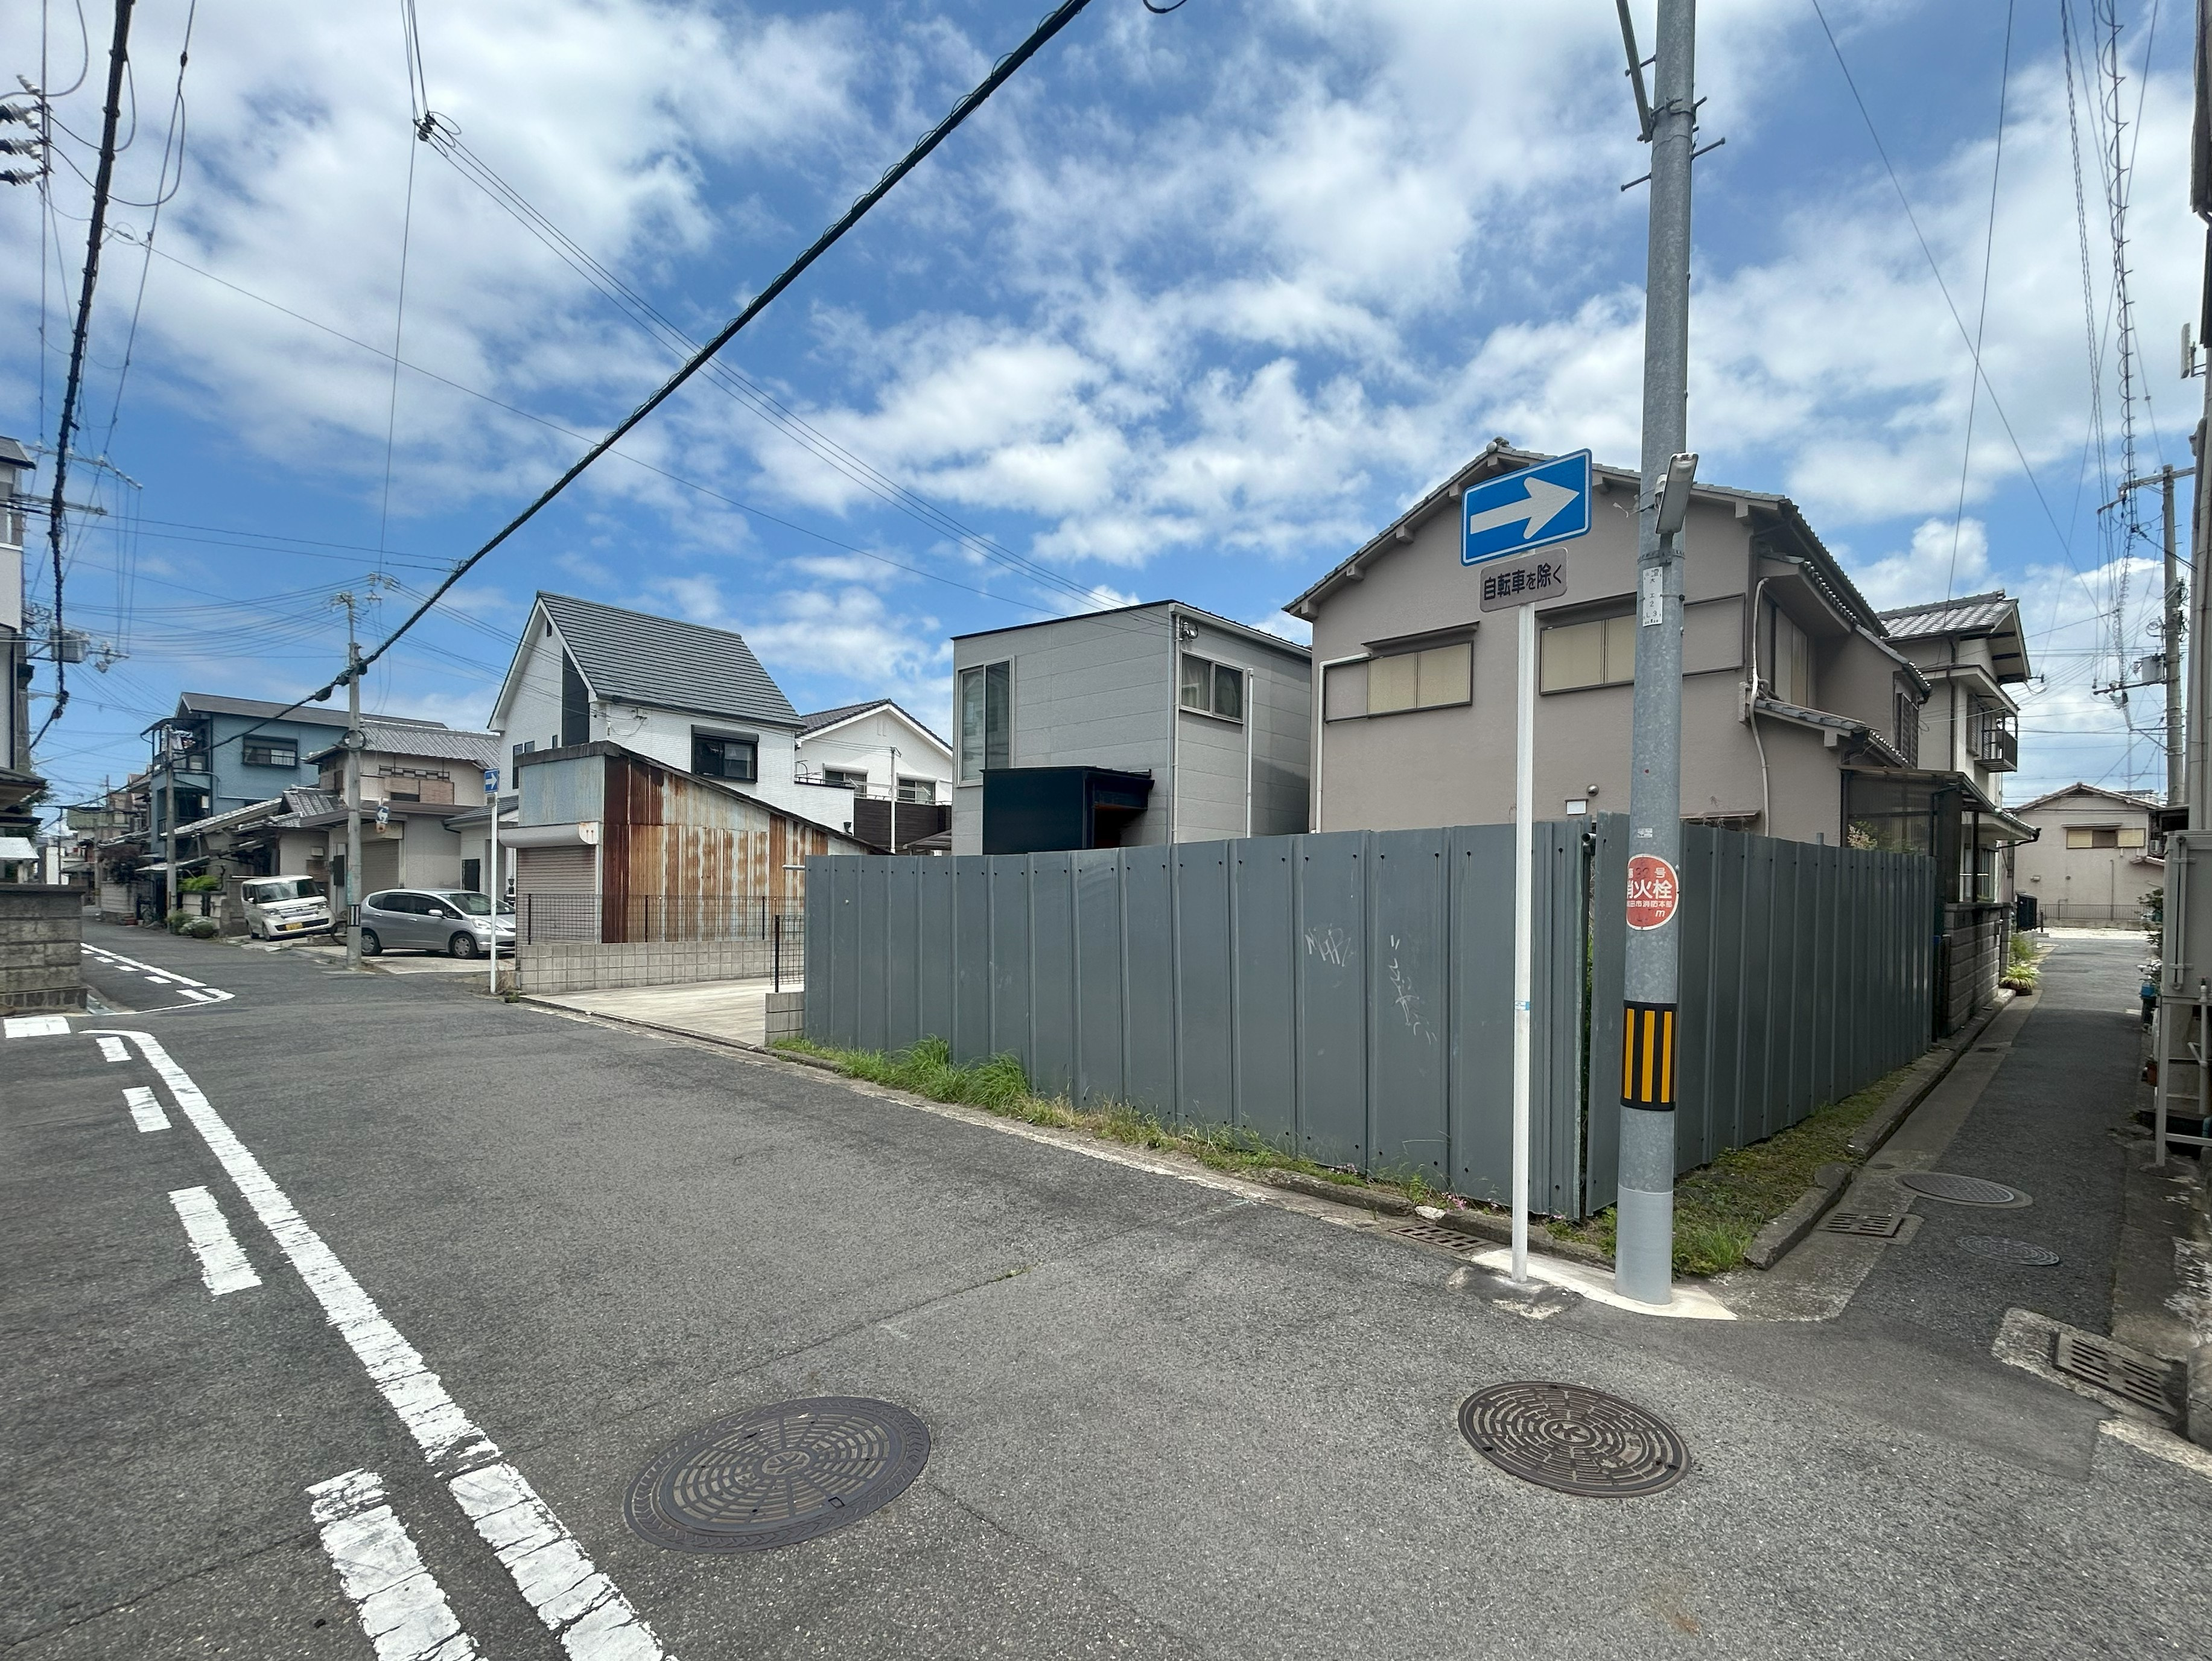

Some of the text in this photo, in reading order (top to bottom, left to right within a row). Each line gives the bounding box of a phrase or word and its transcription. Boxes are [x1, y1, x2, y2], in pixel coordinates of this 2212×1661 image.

[1484, 562, 1562, 600] 自転車を除く
